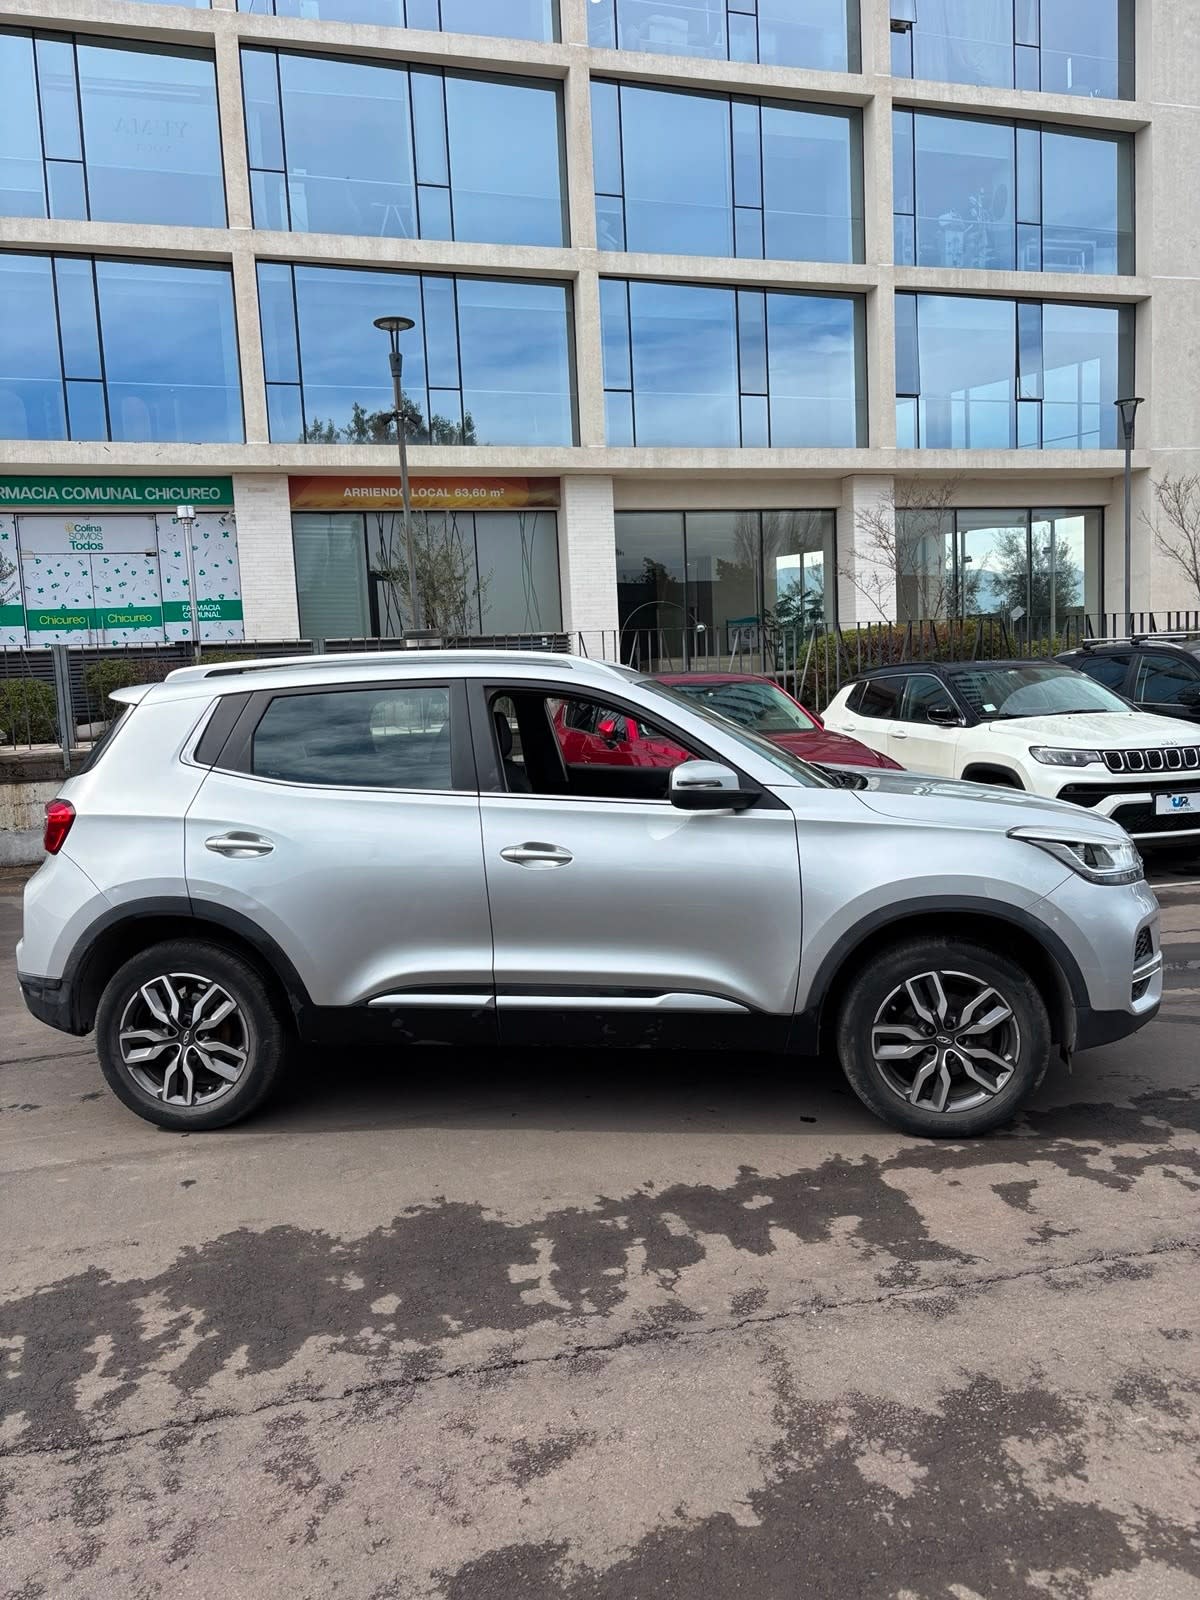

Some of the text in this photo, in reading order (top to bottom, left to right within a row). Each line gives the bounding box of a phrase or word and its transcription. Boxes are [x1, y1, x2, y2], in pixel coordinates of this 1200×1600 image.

[62, 486, 142, 500] COMUNAL
[144, 486, 221, 500] CHICUREO
[411, 487, 450, 497] LOCAL
[74, 524, 102, 532] Colina
[69, 532, 103, 541] SOMOS
[69, 540, 104, 550] Todos
[182, 604, 221, 612] FAMACIA
[39, 615, 86, 625] Chicureo
[107, 613, 153, 624] Chicureo
